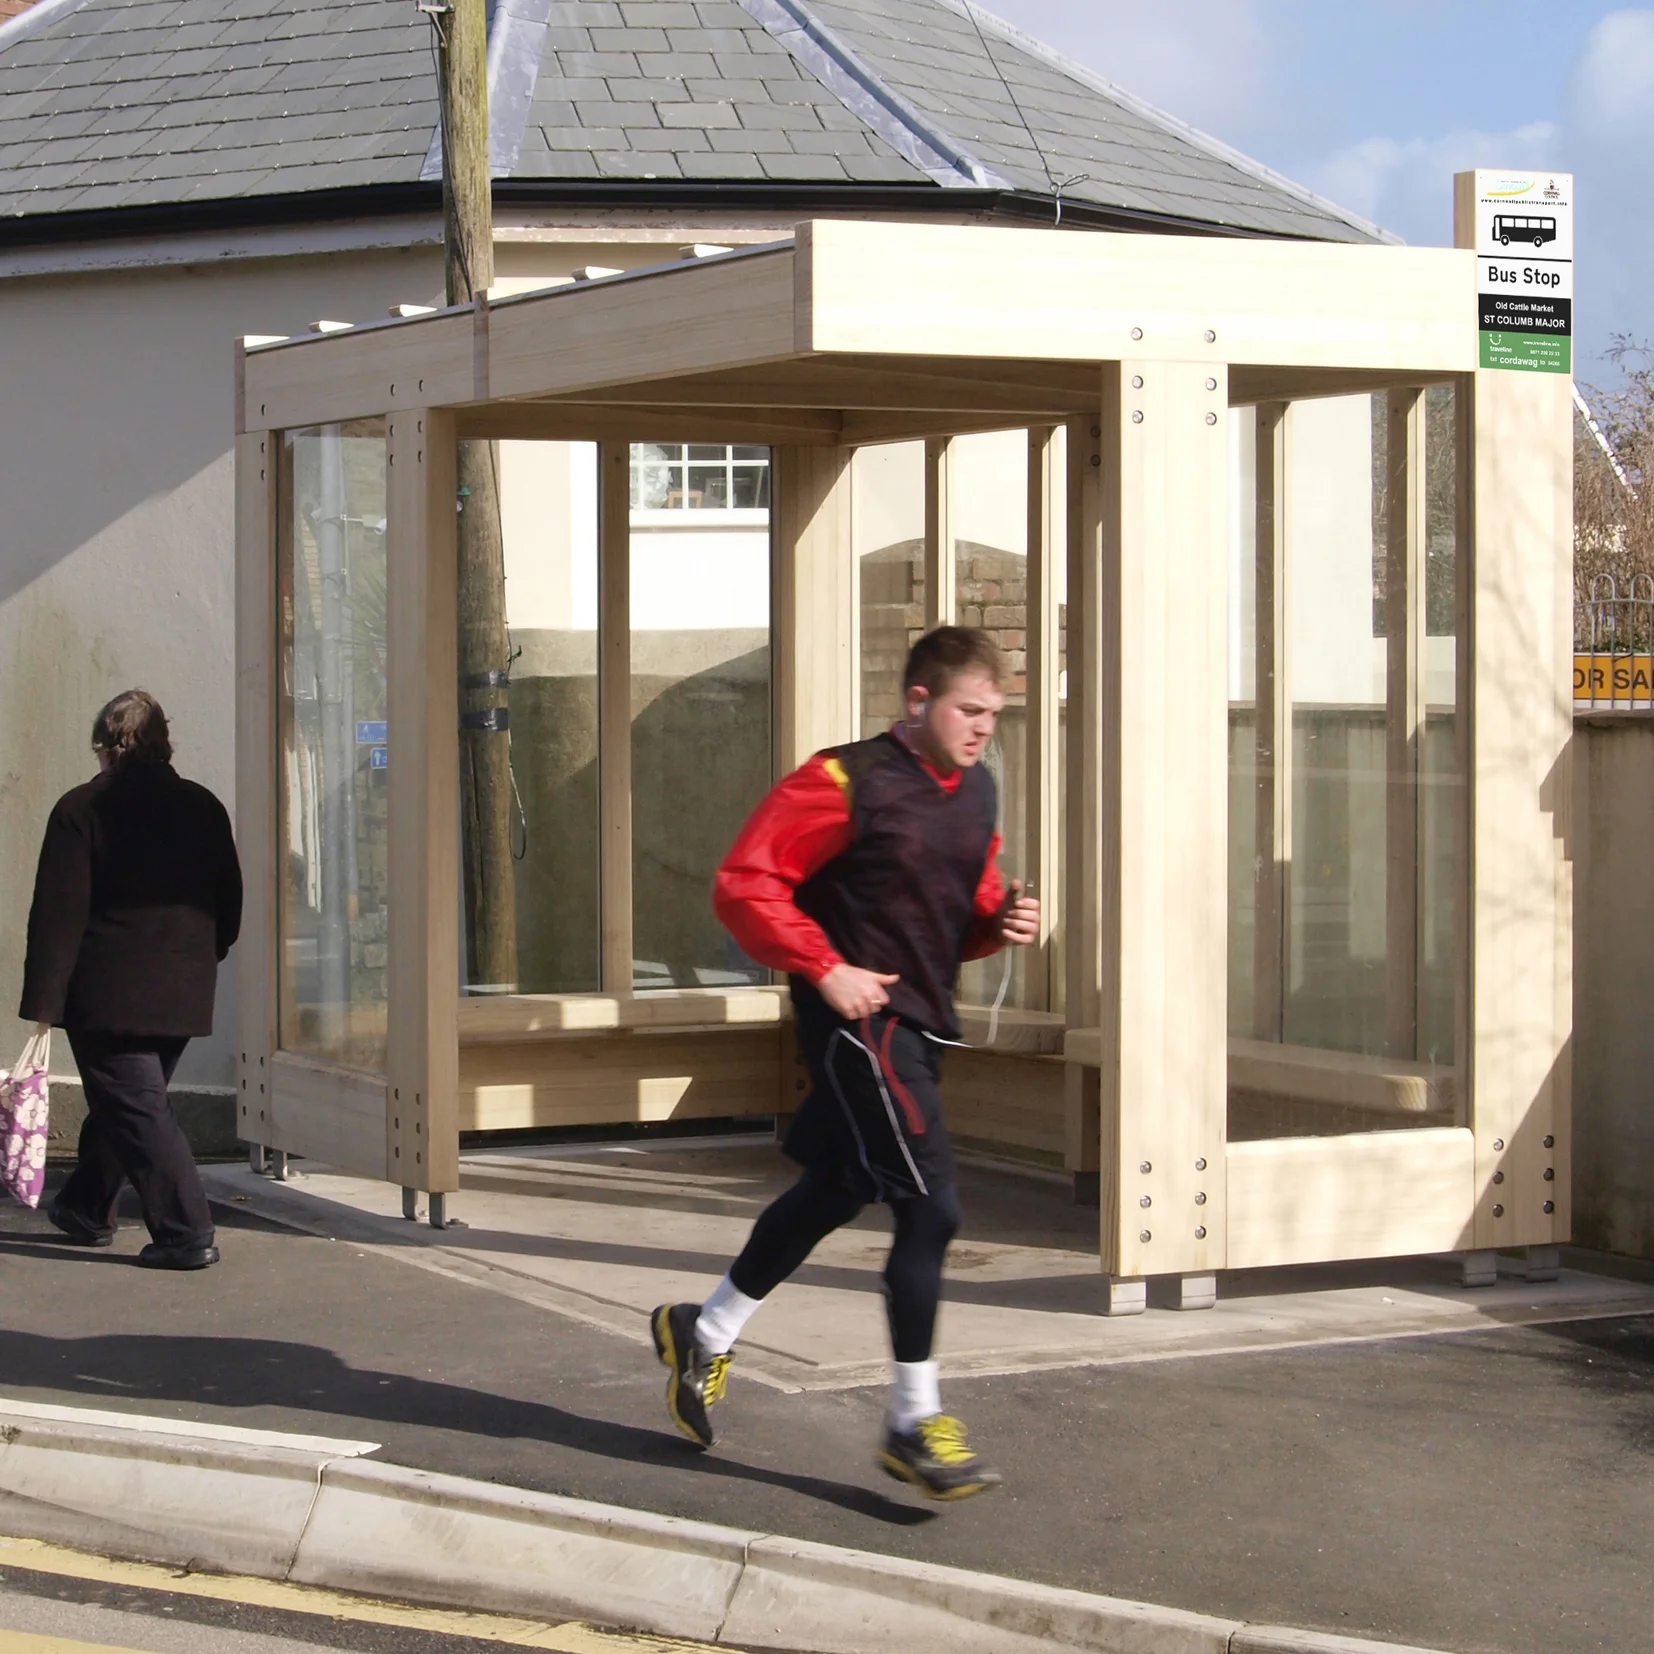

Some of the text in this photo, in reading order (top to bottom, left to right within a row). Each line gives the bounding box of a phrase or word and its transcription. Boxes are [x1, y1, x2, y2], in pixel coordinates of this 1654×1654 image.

[1488, 266, 1560, 288] Bus Stop
[1495, 301, 1554, 313] Old Cattle Market
[1484, 315, 1565, 328] ST COLUMB MAJOR
[1499, 356, 1538, 367] cordawag
[1613, 668, 1654, 690] SA
